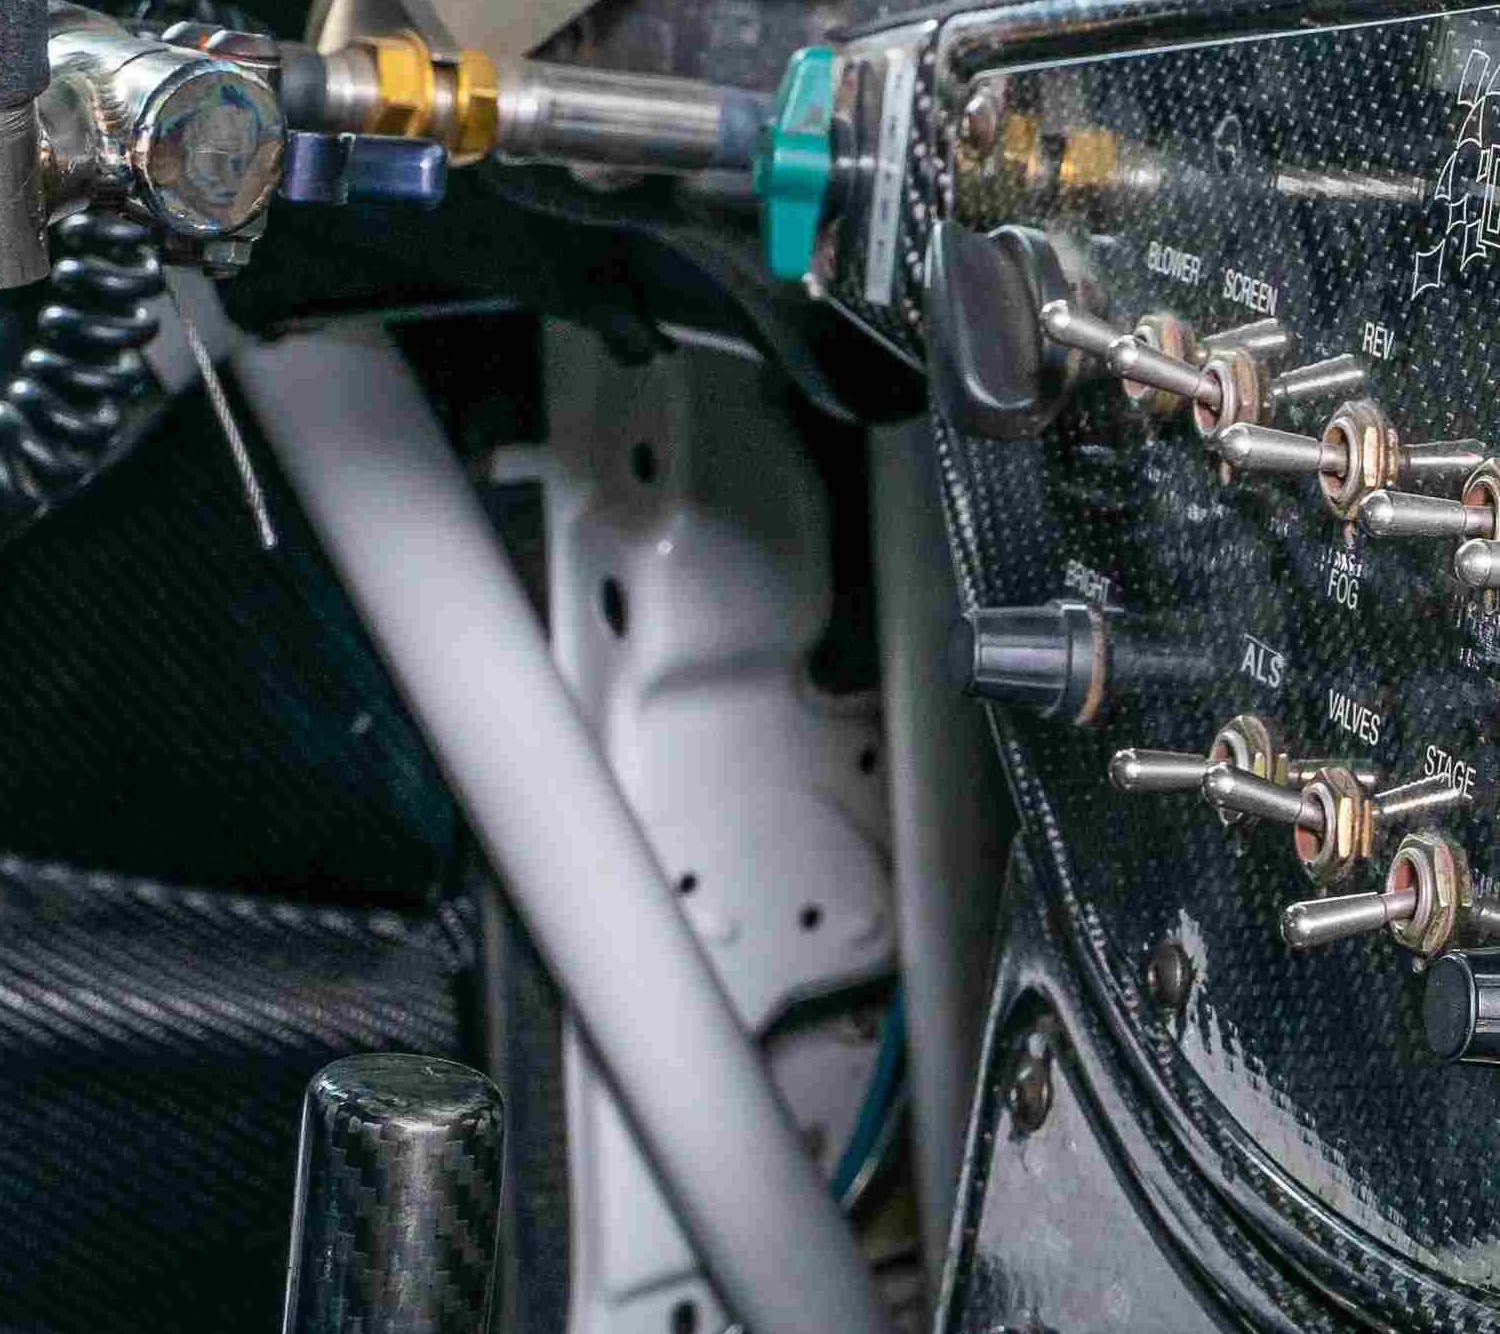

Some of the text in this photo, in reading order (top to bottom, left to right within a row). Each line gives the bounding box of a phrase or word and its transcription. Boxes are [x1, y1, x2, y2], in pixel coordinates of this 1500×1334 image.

[1149, 240, 1201, 286] BLOWER
[1222, 268, 1279, 317] SCREEN
[1362, 322, 1397, 361] REV
[1327, 567, 1359, 610] FOG
[1240, 641, 1282, 689] ALS
[1328, 688, 1382, 747] VALVES
[1423, 744, 1477, 800] STAGE
